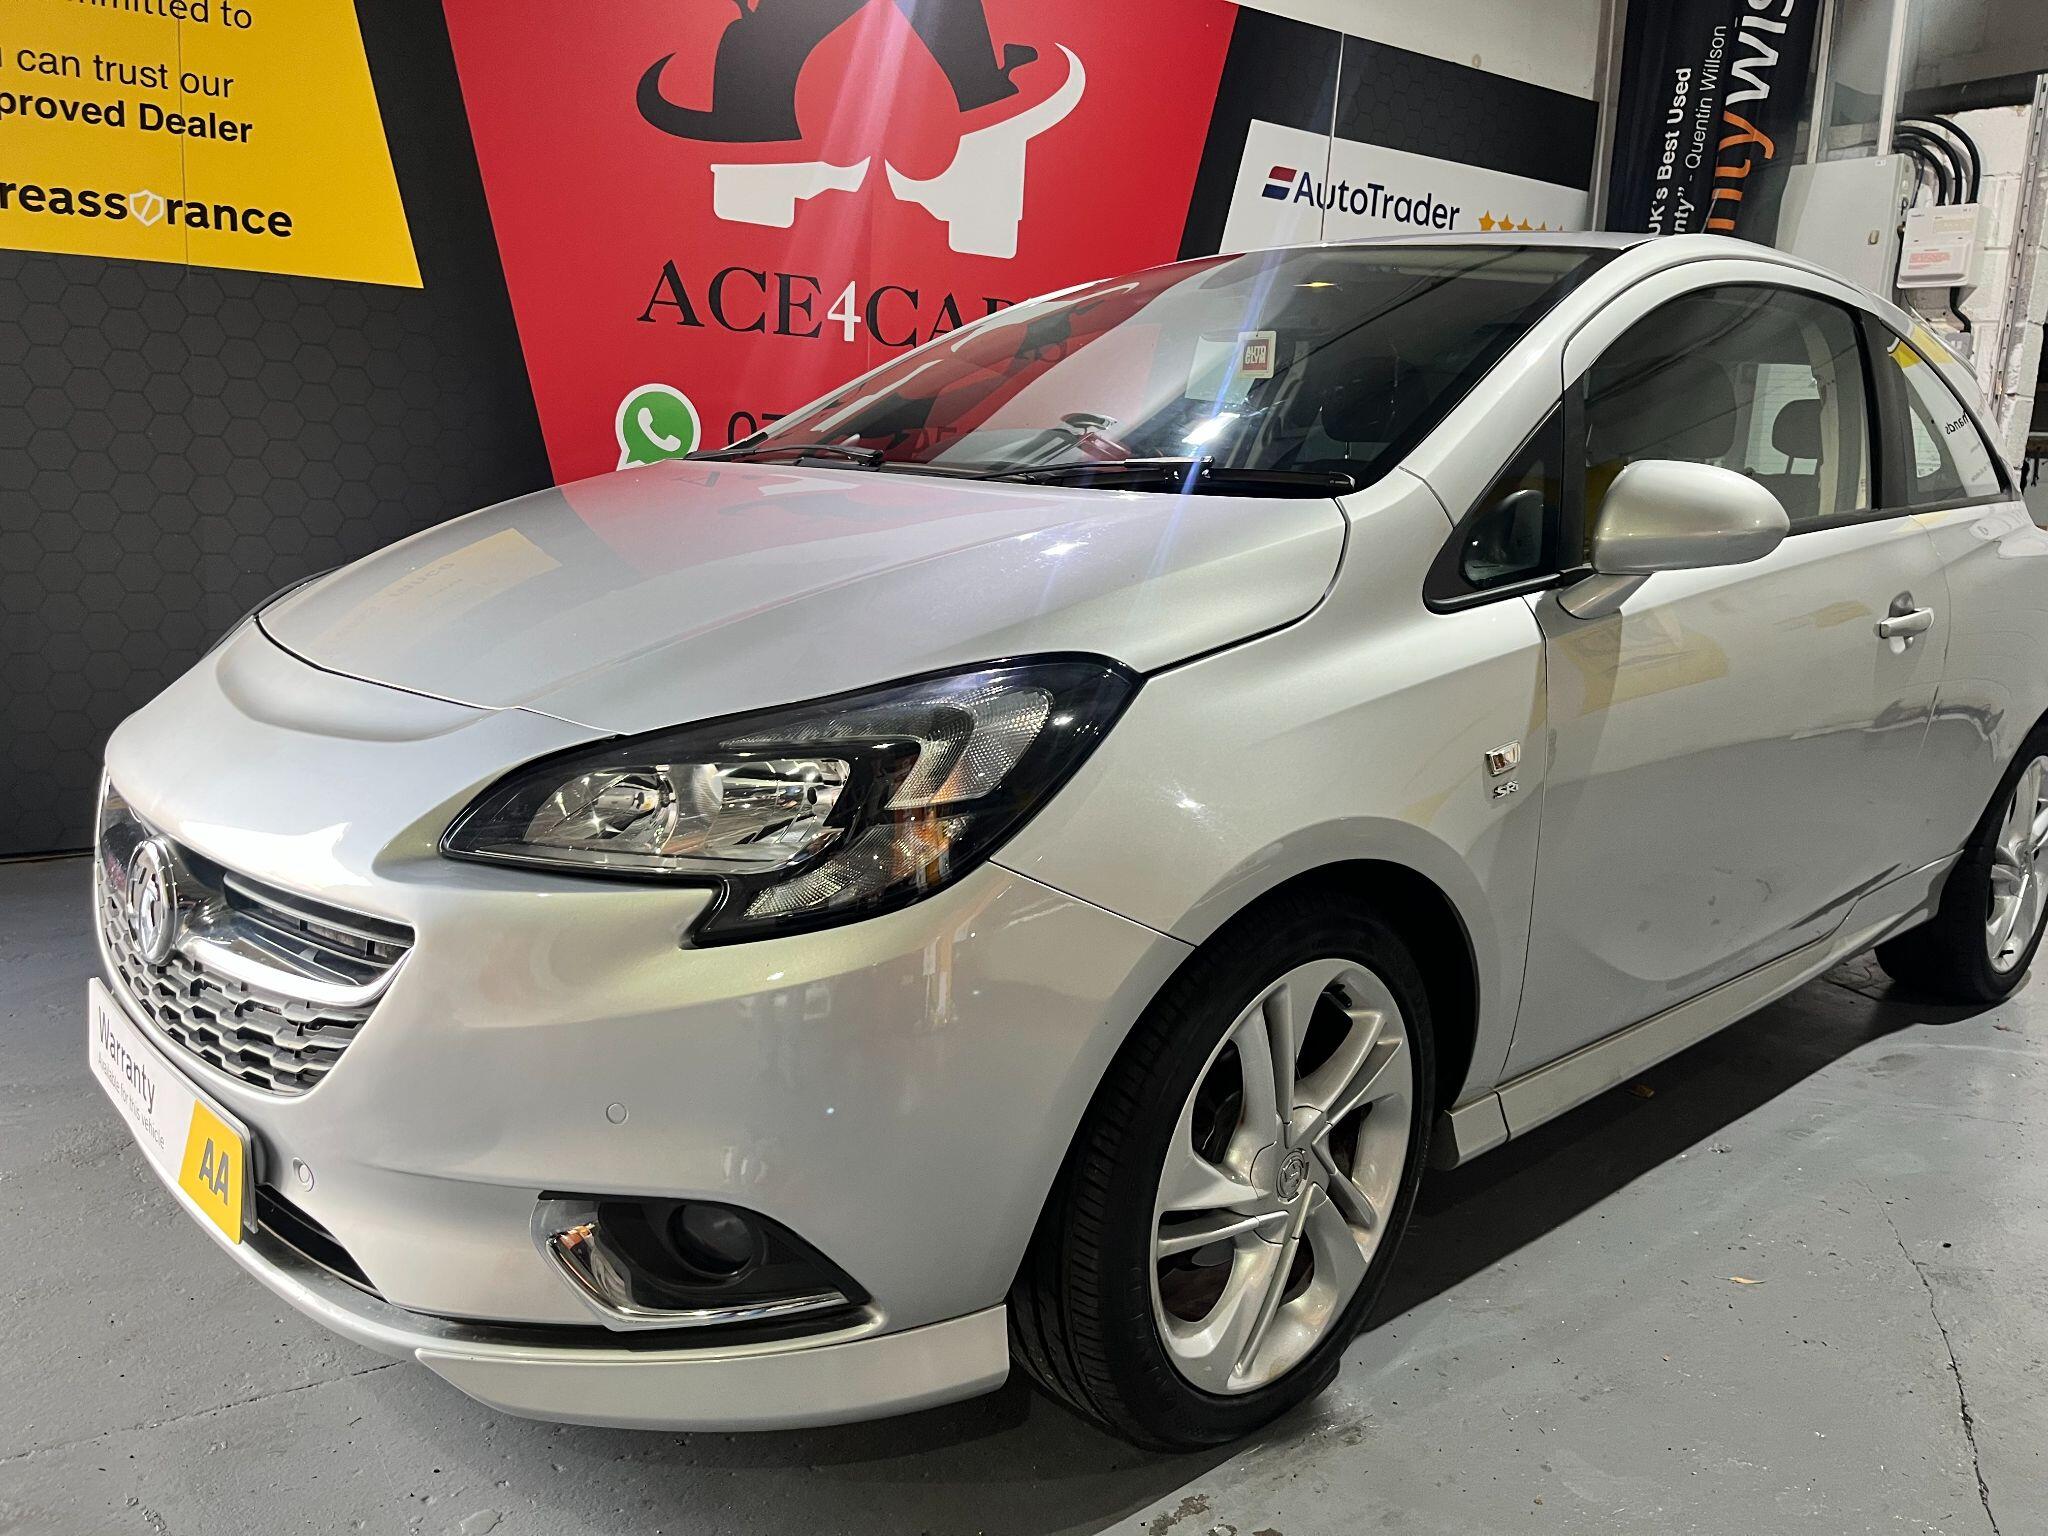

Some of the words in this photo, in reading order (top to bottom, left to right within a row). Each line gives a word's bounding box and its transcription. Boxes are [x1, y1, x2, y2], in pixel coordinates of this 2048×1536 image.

[220, 0, 252, 29] to
[17, 49, 80, 78] can
[93, 54, 168, 90] trust
[180, 72, 234, 98] our
[1667, 68, 1692, 124] Used
[1685, 97, 1713, 169] Quentin
[1700, 25, 1727, 91] Willson
[139, 102, 253, 143] Dealer
[1656, 130, 1680, 180] Best
[1293, 171, 1461, 231] AutoTrader
[98, 1005, 155, 1114] Warranty
[141, 1113, 165, 1150] vehicle
[198, 1137, 229, 1206] AA
